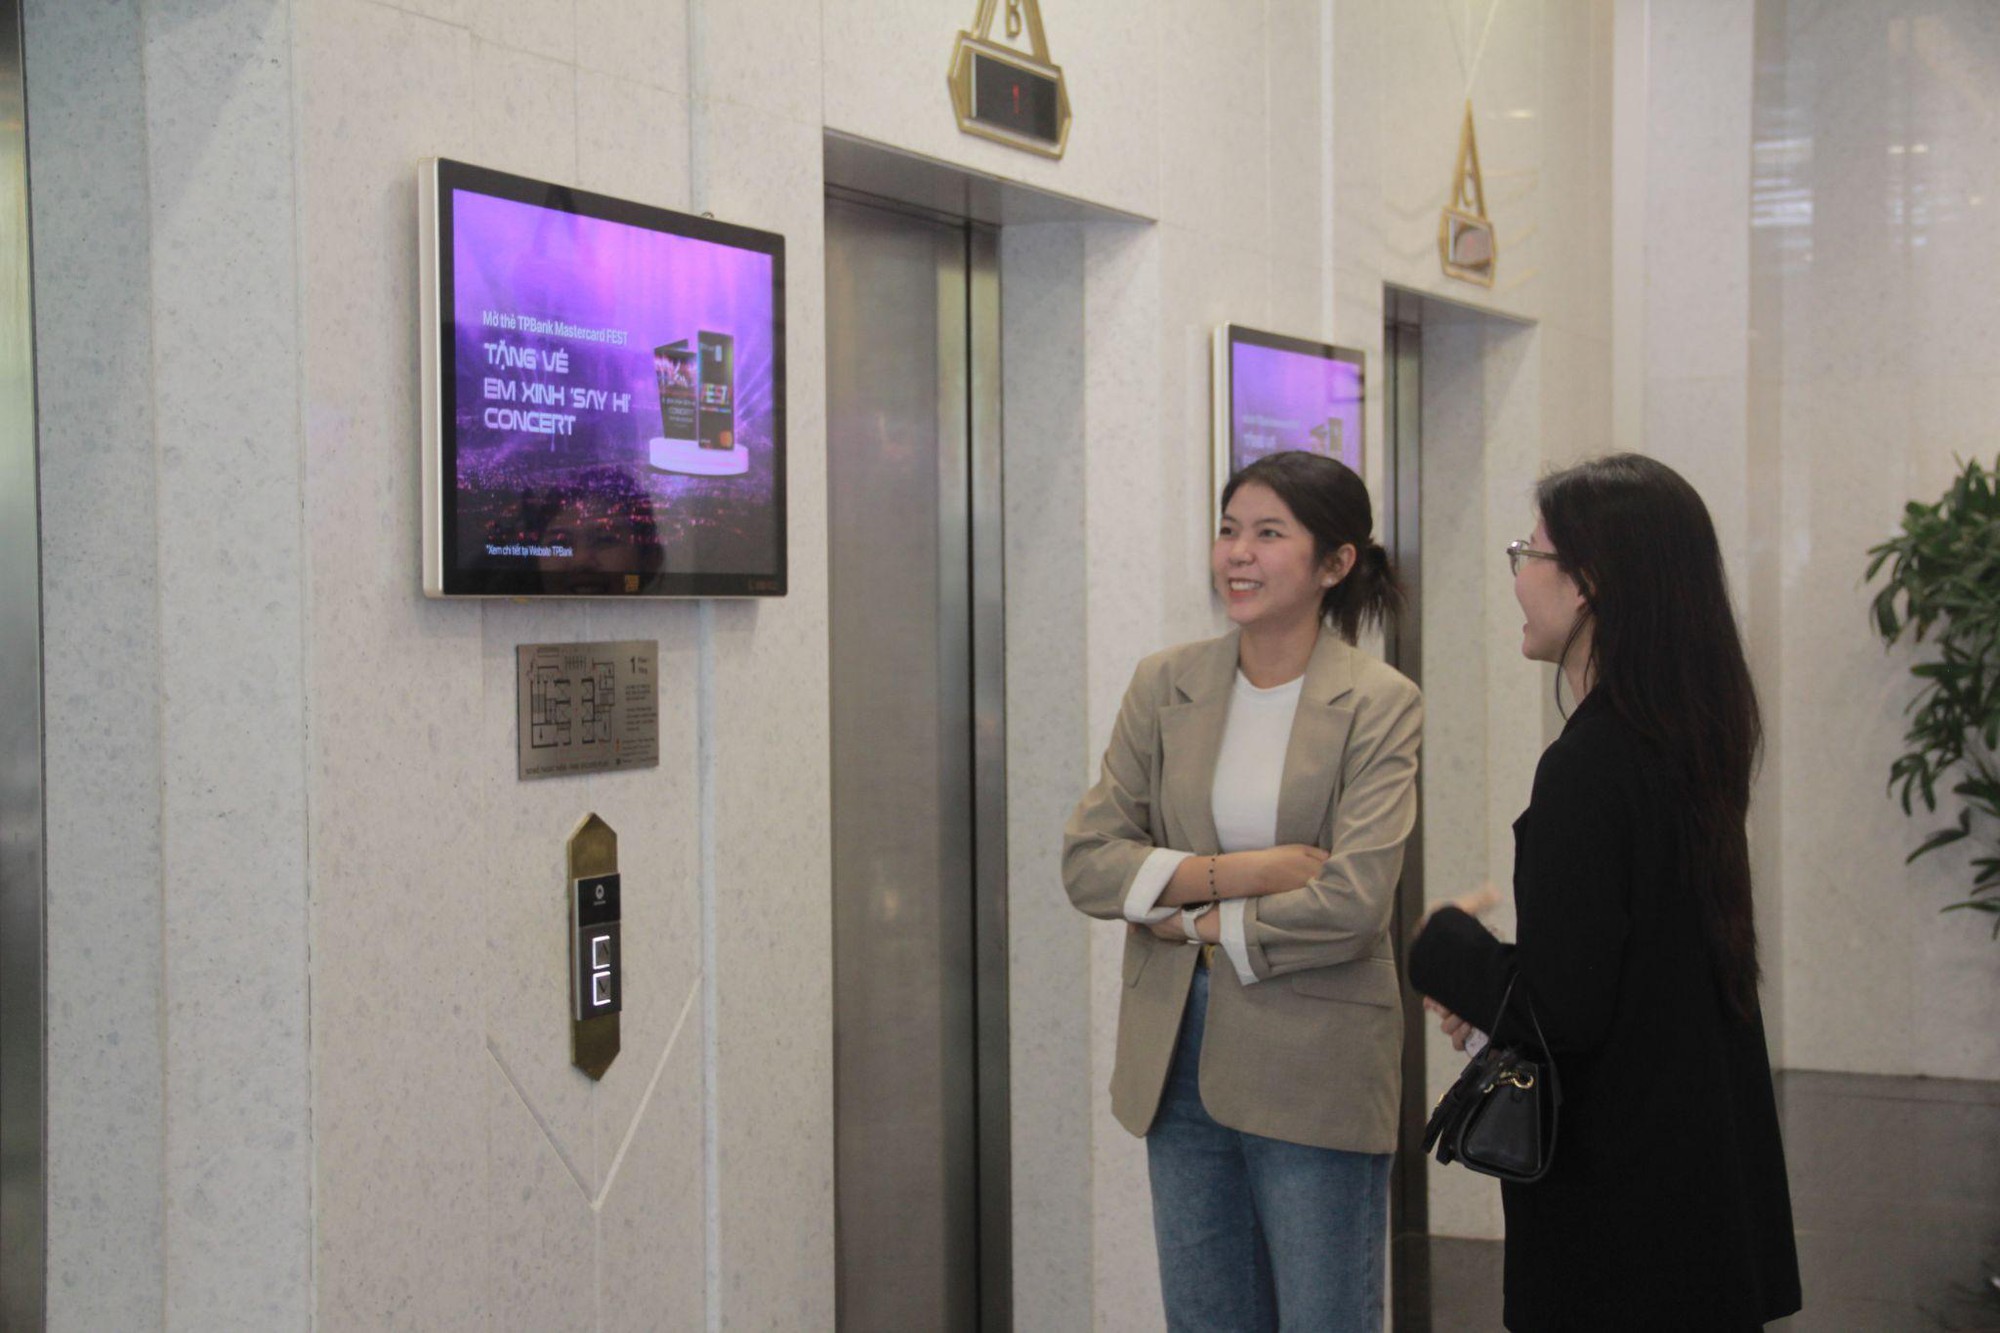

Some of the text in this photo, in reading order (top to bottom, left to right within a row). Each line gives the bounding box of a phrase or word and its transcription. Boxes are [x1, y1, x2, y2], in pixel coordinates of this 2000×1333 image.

[517, 315, 554, 335] TPBank
[554, 320, 605, 343] Mastercard
[606, 328, 628, 345] FEST
[484, 338, 569, 374] TẶNG VÉ
[484, 377, 516, 401] EM
[521, 382, 565, 406] XINH
[484, 407, 576, 436] CONCERT
[552, 546, 573, 557] TPBank
